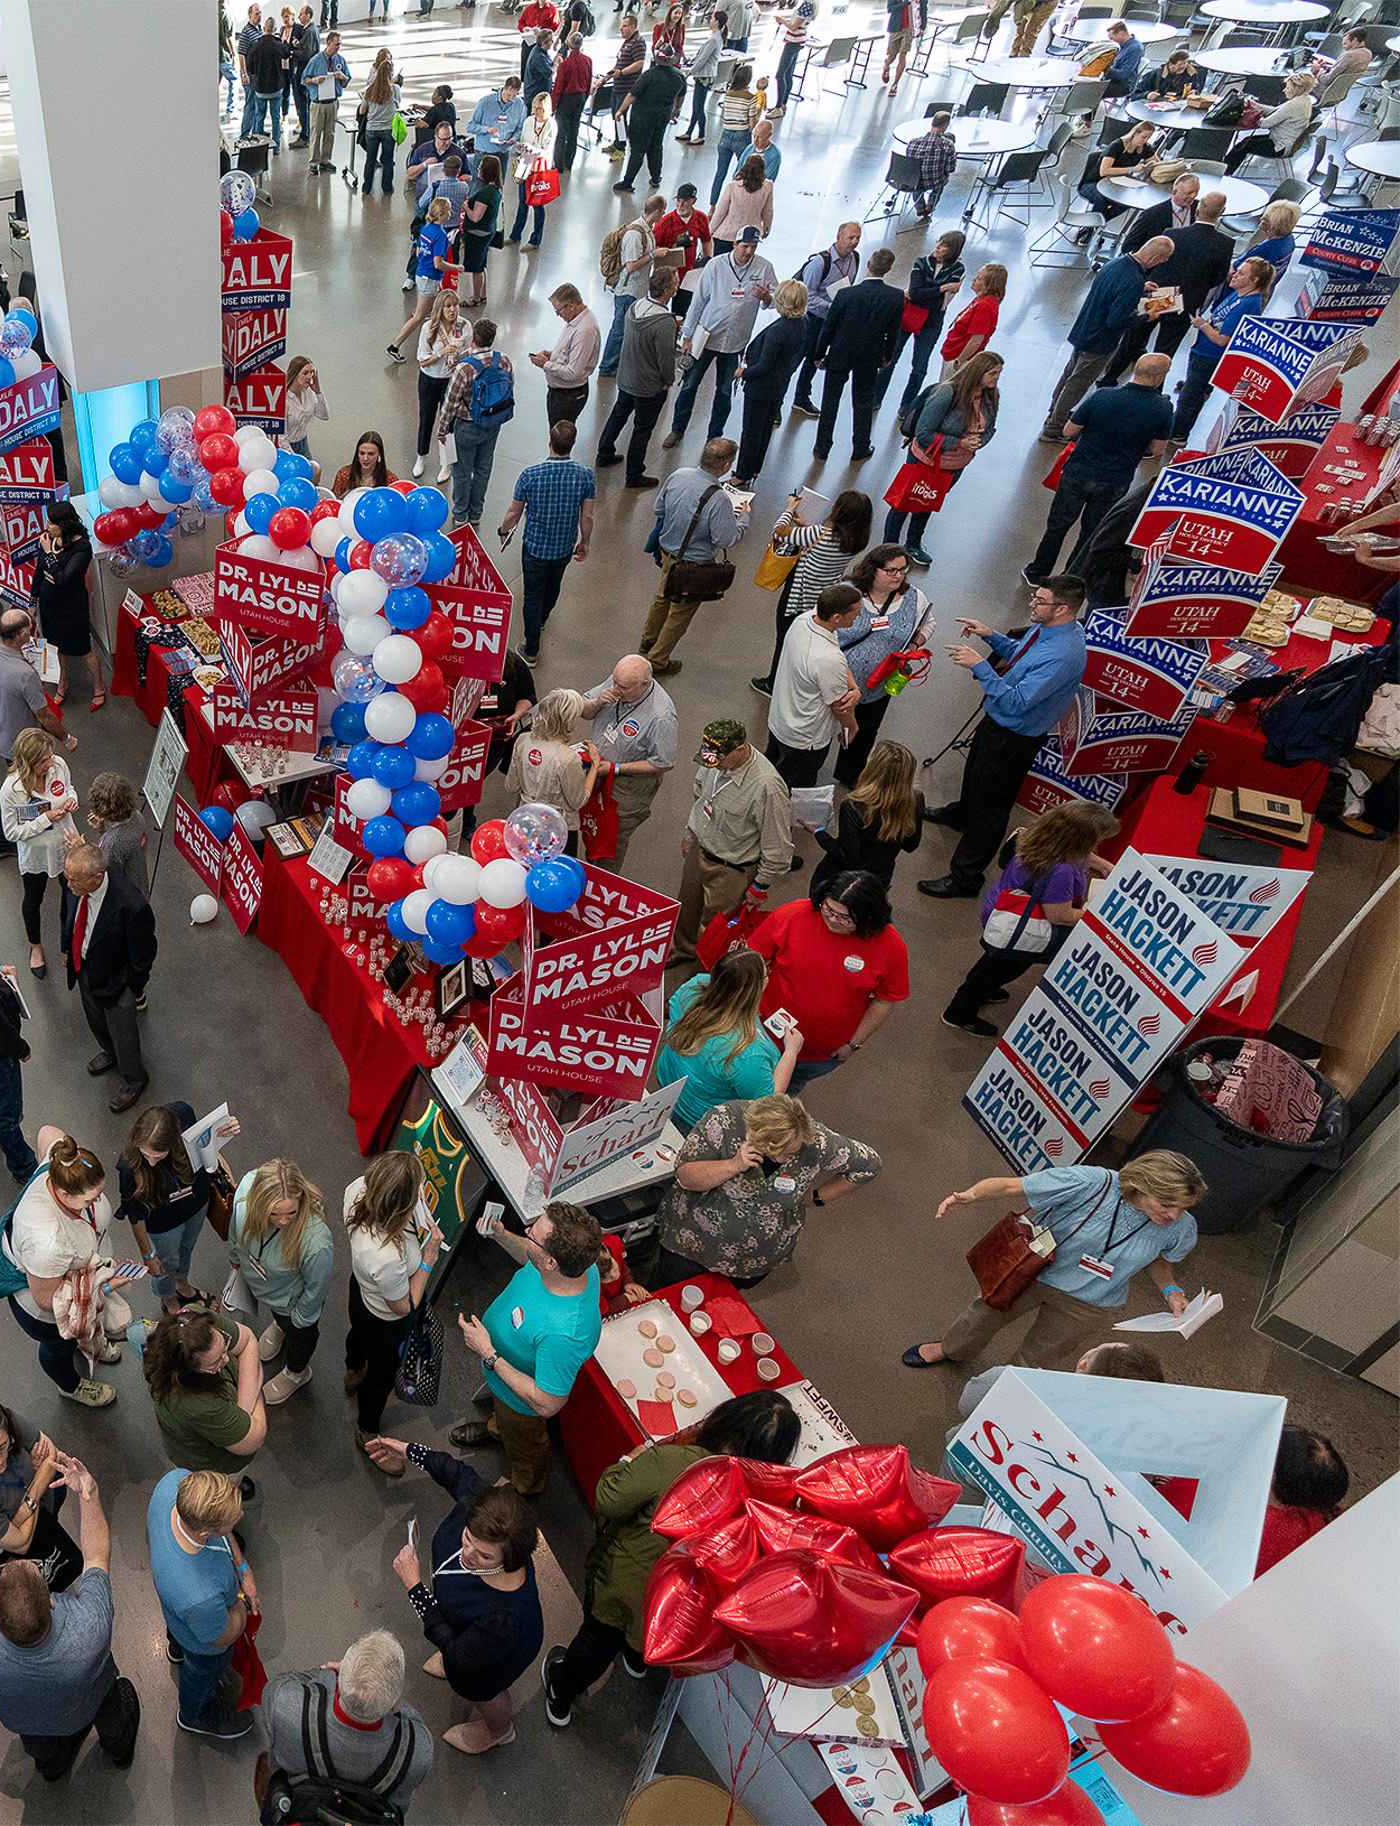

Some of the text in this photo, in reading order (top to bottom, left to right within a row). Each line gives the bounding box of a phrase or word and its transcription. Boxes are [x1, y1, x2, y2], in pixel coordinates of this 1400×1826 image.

[1318, 217, 1354, 234] BRIAN
[1312, 230, 1386, 259] McKENZIE
[241, 294, 285, 305] DISTRICT 18
[1317, 295, 1391, 307] McKENZIE
[1324, 284, 1360, 293] BRIAN
[237, 309, 285, 356] DALY
[1238, 322, 1311, 372] KARIANNE
[242, 347, 276, 372] HOUSE DISTRICT
[1243, 366, 1272, 389] UTAH
[225, 385, 283, 412] ALY
[5, 419, 48, 446] HOUSE DISTRICT
[237, 420, 270, 428] DISTRICT
[1232, 415, 1335, 433] KARIANNE
[1160, 475, 1297, 519] KARIANNE
[1179, 531, 1228, 547] HOUSE DISTRICT
[1183, 521, 1233, 542] UTAH
[1187, 541, 1210, 555] 14
[219, 561, 320, 599] DR. LYLE
[1154, 569, 1278, 586] KARIANNE
[218, 580, 318, 622] MASON
[1174, 607, 1220, 617] UTAH
[240, 609, 291, 628] UTAH HOUSE
[1177, 622, 1200, 633] 14
[253, 634, 323, 691] MASON
[254, 647, 279, 671] DR.
[1105, 663, 1148, 687] UTAH
[1109, 682, 1130, 698] 14
[217, 711, 313, 734] MASON
[1108, 745, 1147, 756] UTAH
[1112, 760, 1129, 770] 14
[176, 804, 220, 863] DR. LYLE
[228, 832, 242, 859] DR.
[176, 818, 219, 879] MASON
[222, 846, 257, 915] MASON
[1119, 869, 1196, 946] JASON
[537, 920, 673, 979] DR. LYLE
[1099, 889, 1206, 998] HACKETT
[533, 943, 667, 1005] MASON
[1071, 942, 1141, 1015] JASON
[1105, 933, 1167, 997] State House District 15
[562, 980, 629, 1010] UTAH HOUSE
[1053, 959, 1150, 1065] HACKETT
[1057, 999, 1069, 1012] Vote
[1068, 1010, 1083, 1028] Jason.
[1083, 1026, 1094, 1042] Vote
[560, 1024, 652, 1053] LYLE
[1028, 1008, 1093, 1079] JASON
[496, 1033, 646, 1077] MASON
[527, 1064, 603, 1084] UTAH HOUSE
[1011, 1022, 1101, 1126] HACKETT
[1015, 1060, 1027, 1073] Vote
[1038, 1087, 1049, 1101] Vote
[989, 1068, 1048, 1137] JASON
[560, 1105, 671, 1180] Scharf
[967, 1460, 1067, 1571] Davis County
